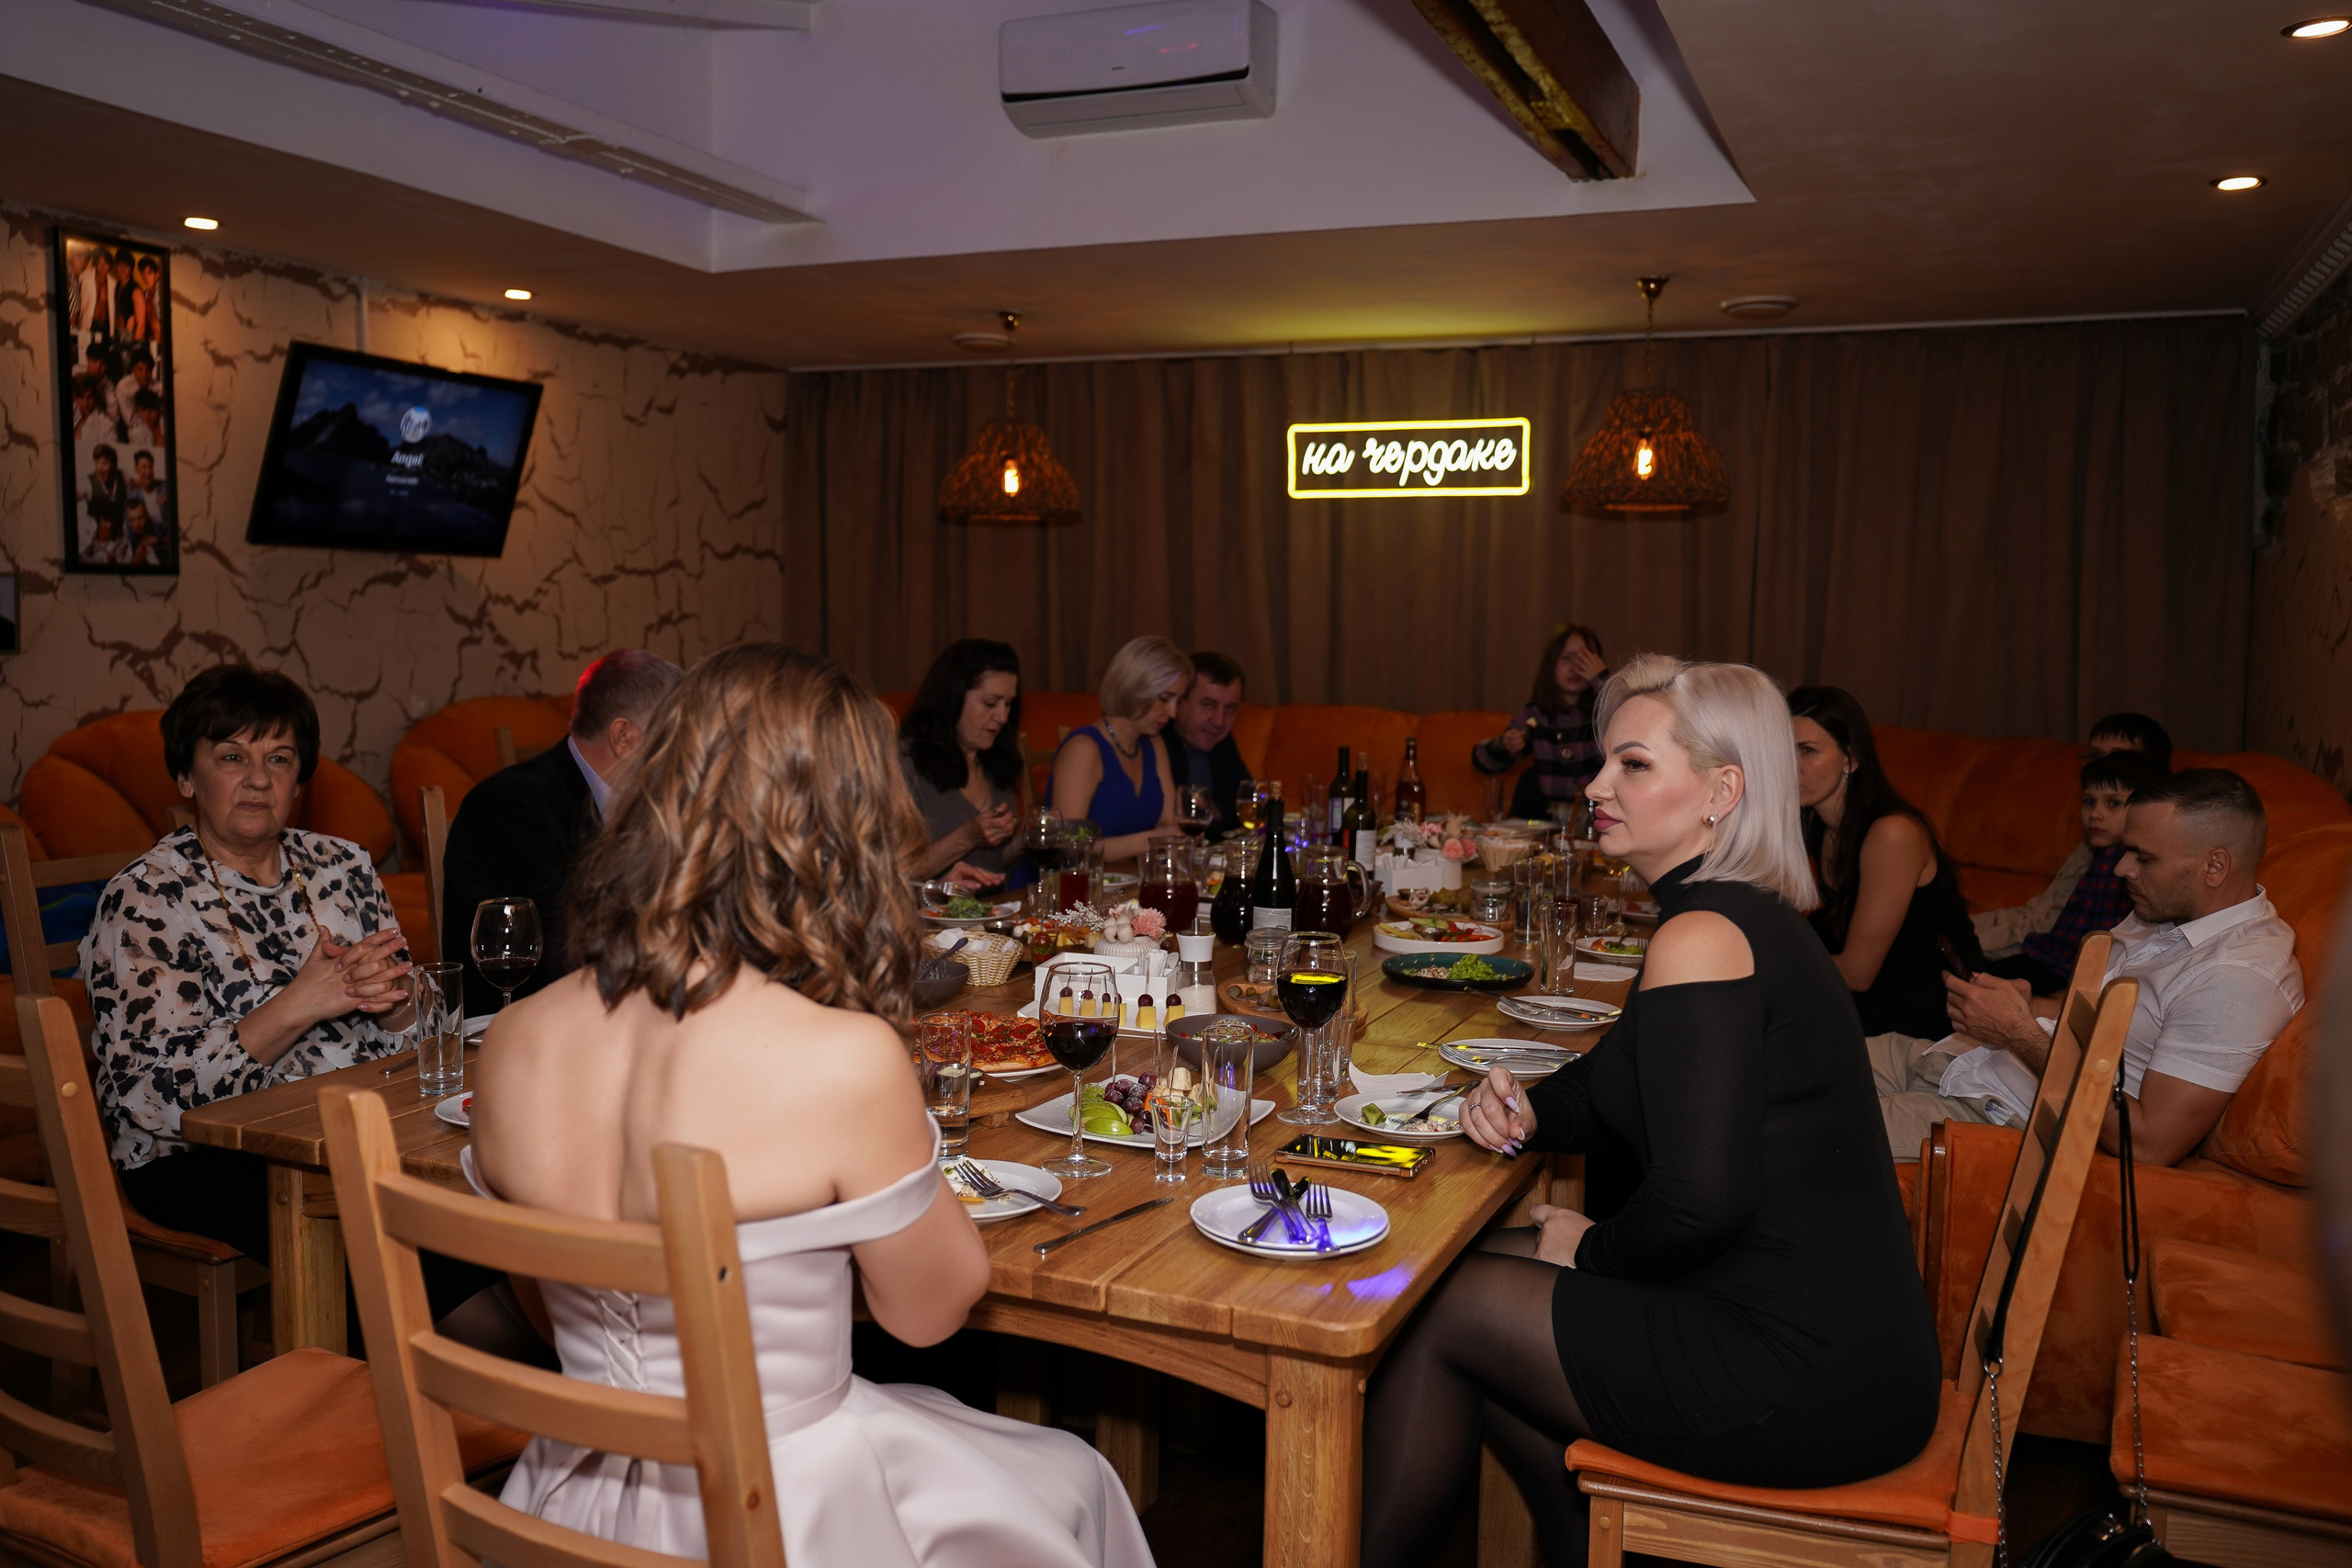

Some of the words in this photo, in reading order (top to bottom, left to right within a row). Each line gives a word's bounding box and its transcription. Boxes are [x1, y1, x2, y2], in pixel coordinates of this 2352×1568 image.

[390, 450, 424, 468] Angel
[1302, 442, 1355, 475] на
[1362, 437, 1517, 487] чердаке
